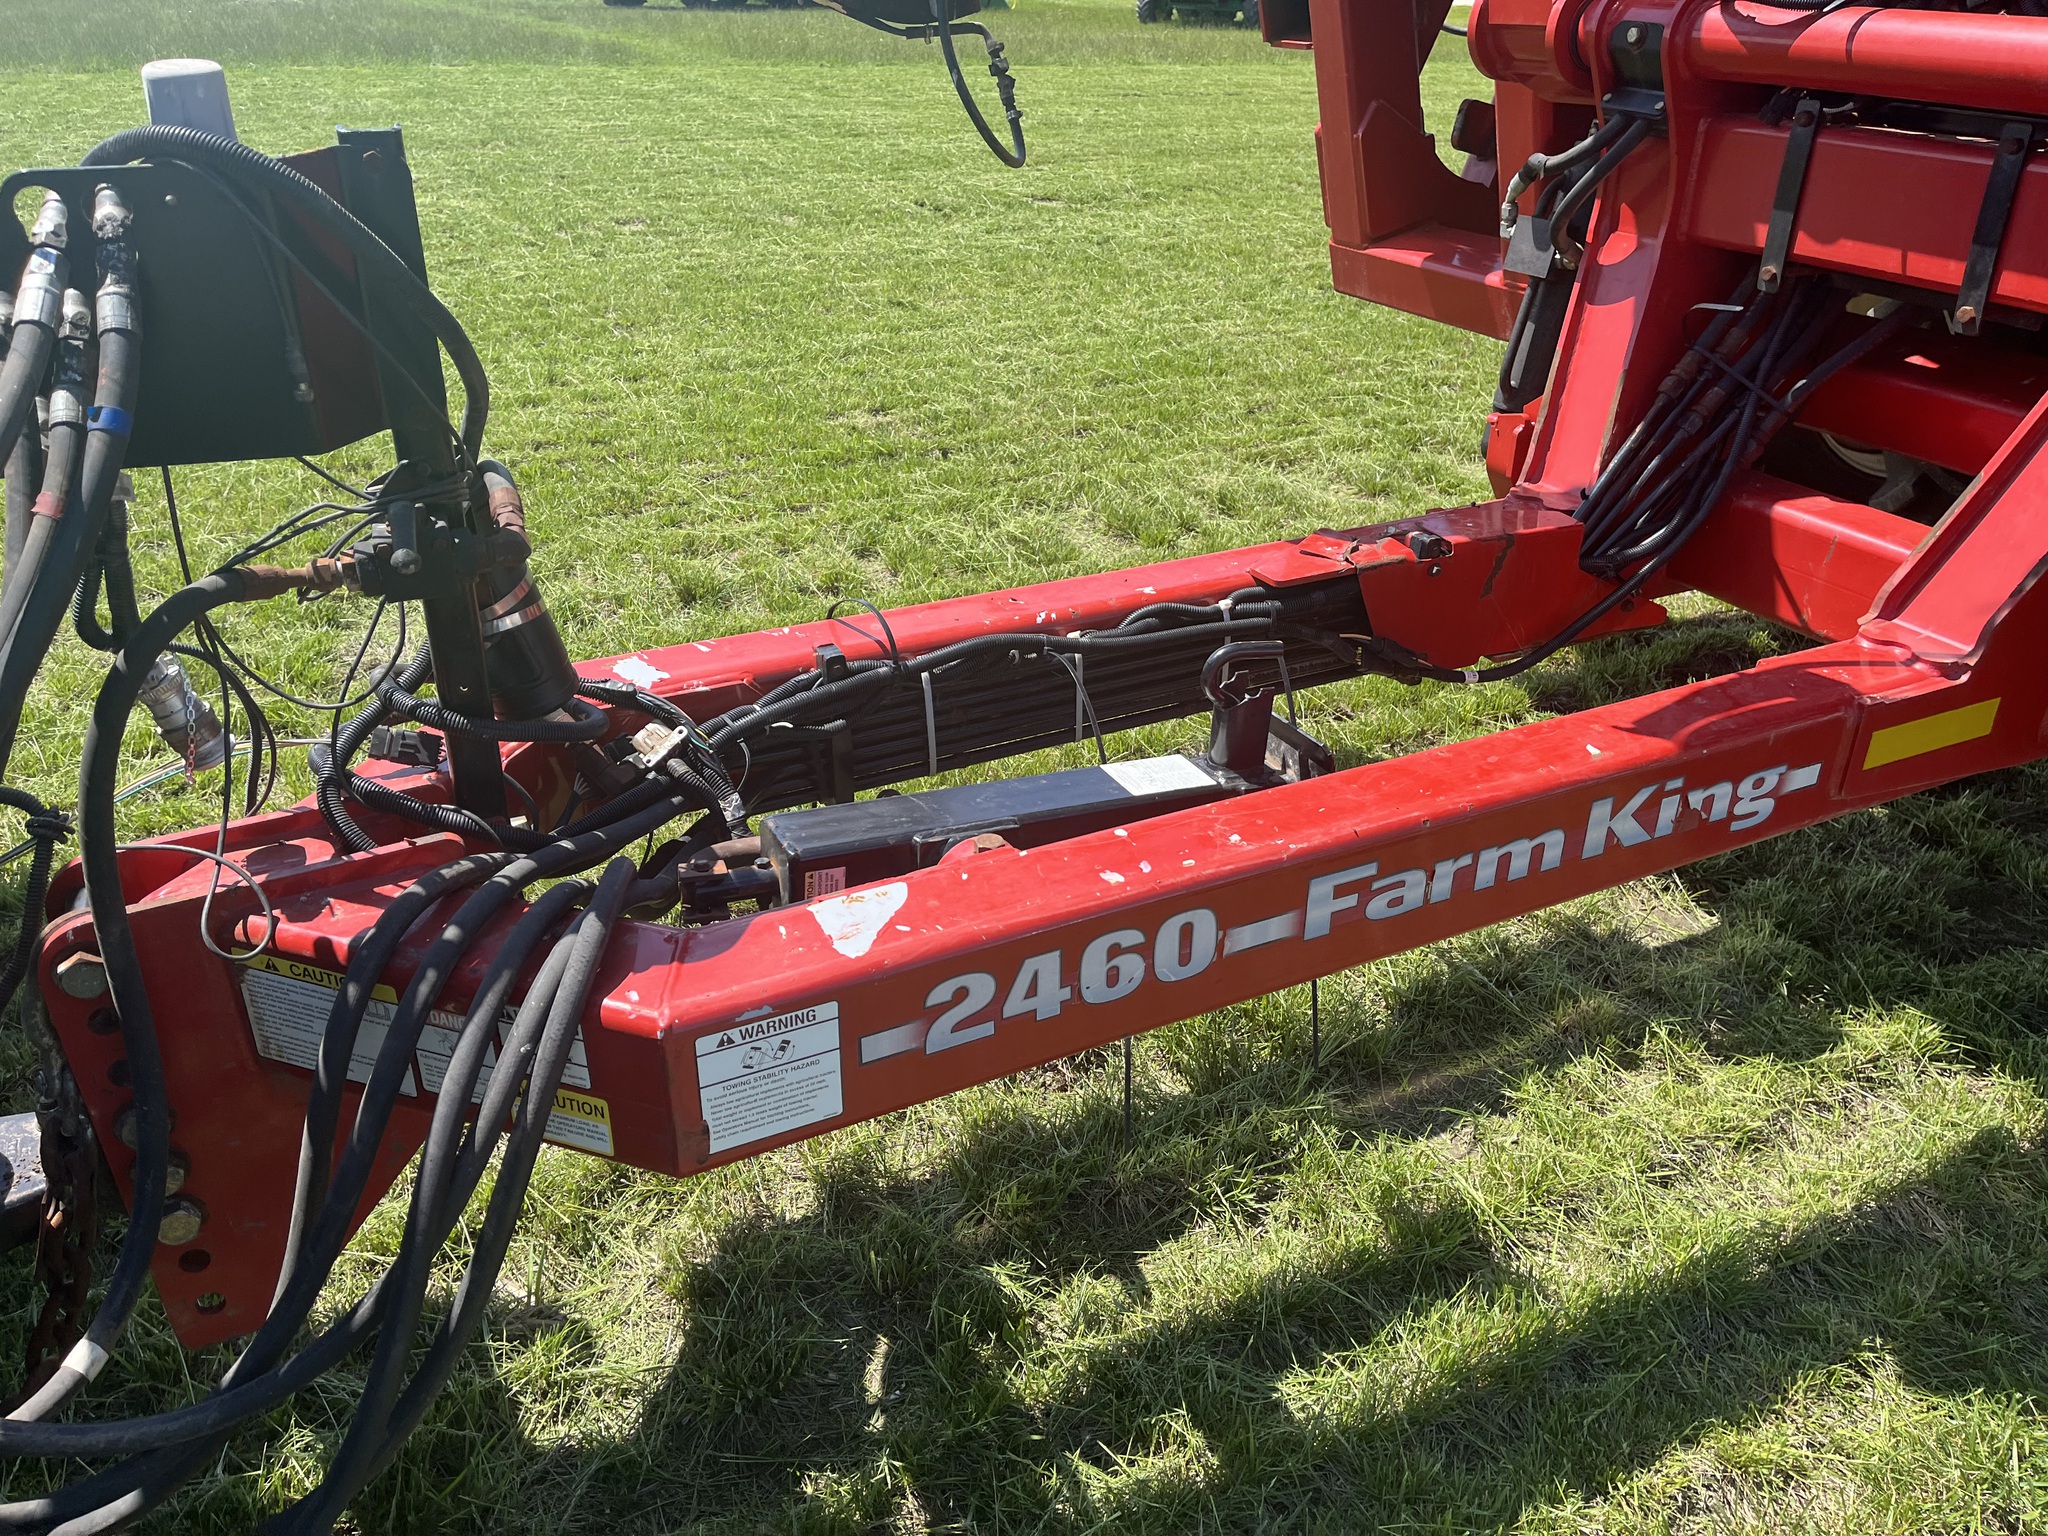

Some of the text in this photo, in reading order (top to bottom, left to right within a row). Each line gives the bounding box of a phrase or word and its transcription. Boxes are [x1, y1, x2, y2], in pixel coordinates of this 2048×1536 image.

[924, 765, 1787, 1055] 2460 Farm King
[739, 1010, 816, 1041] WARNING
[721, 1059, 819, 1091] TOWING STABILITY HAZARD
[553, 1095, 604, 1119] UTION
